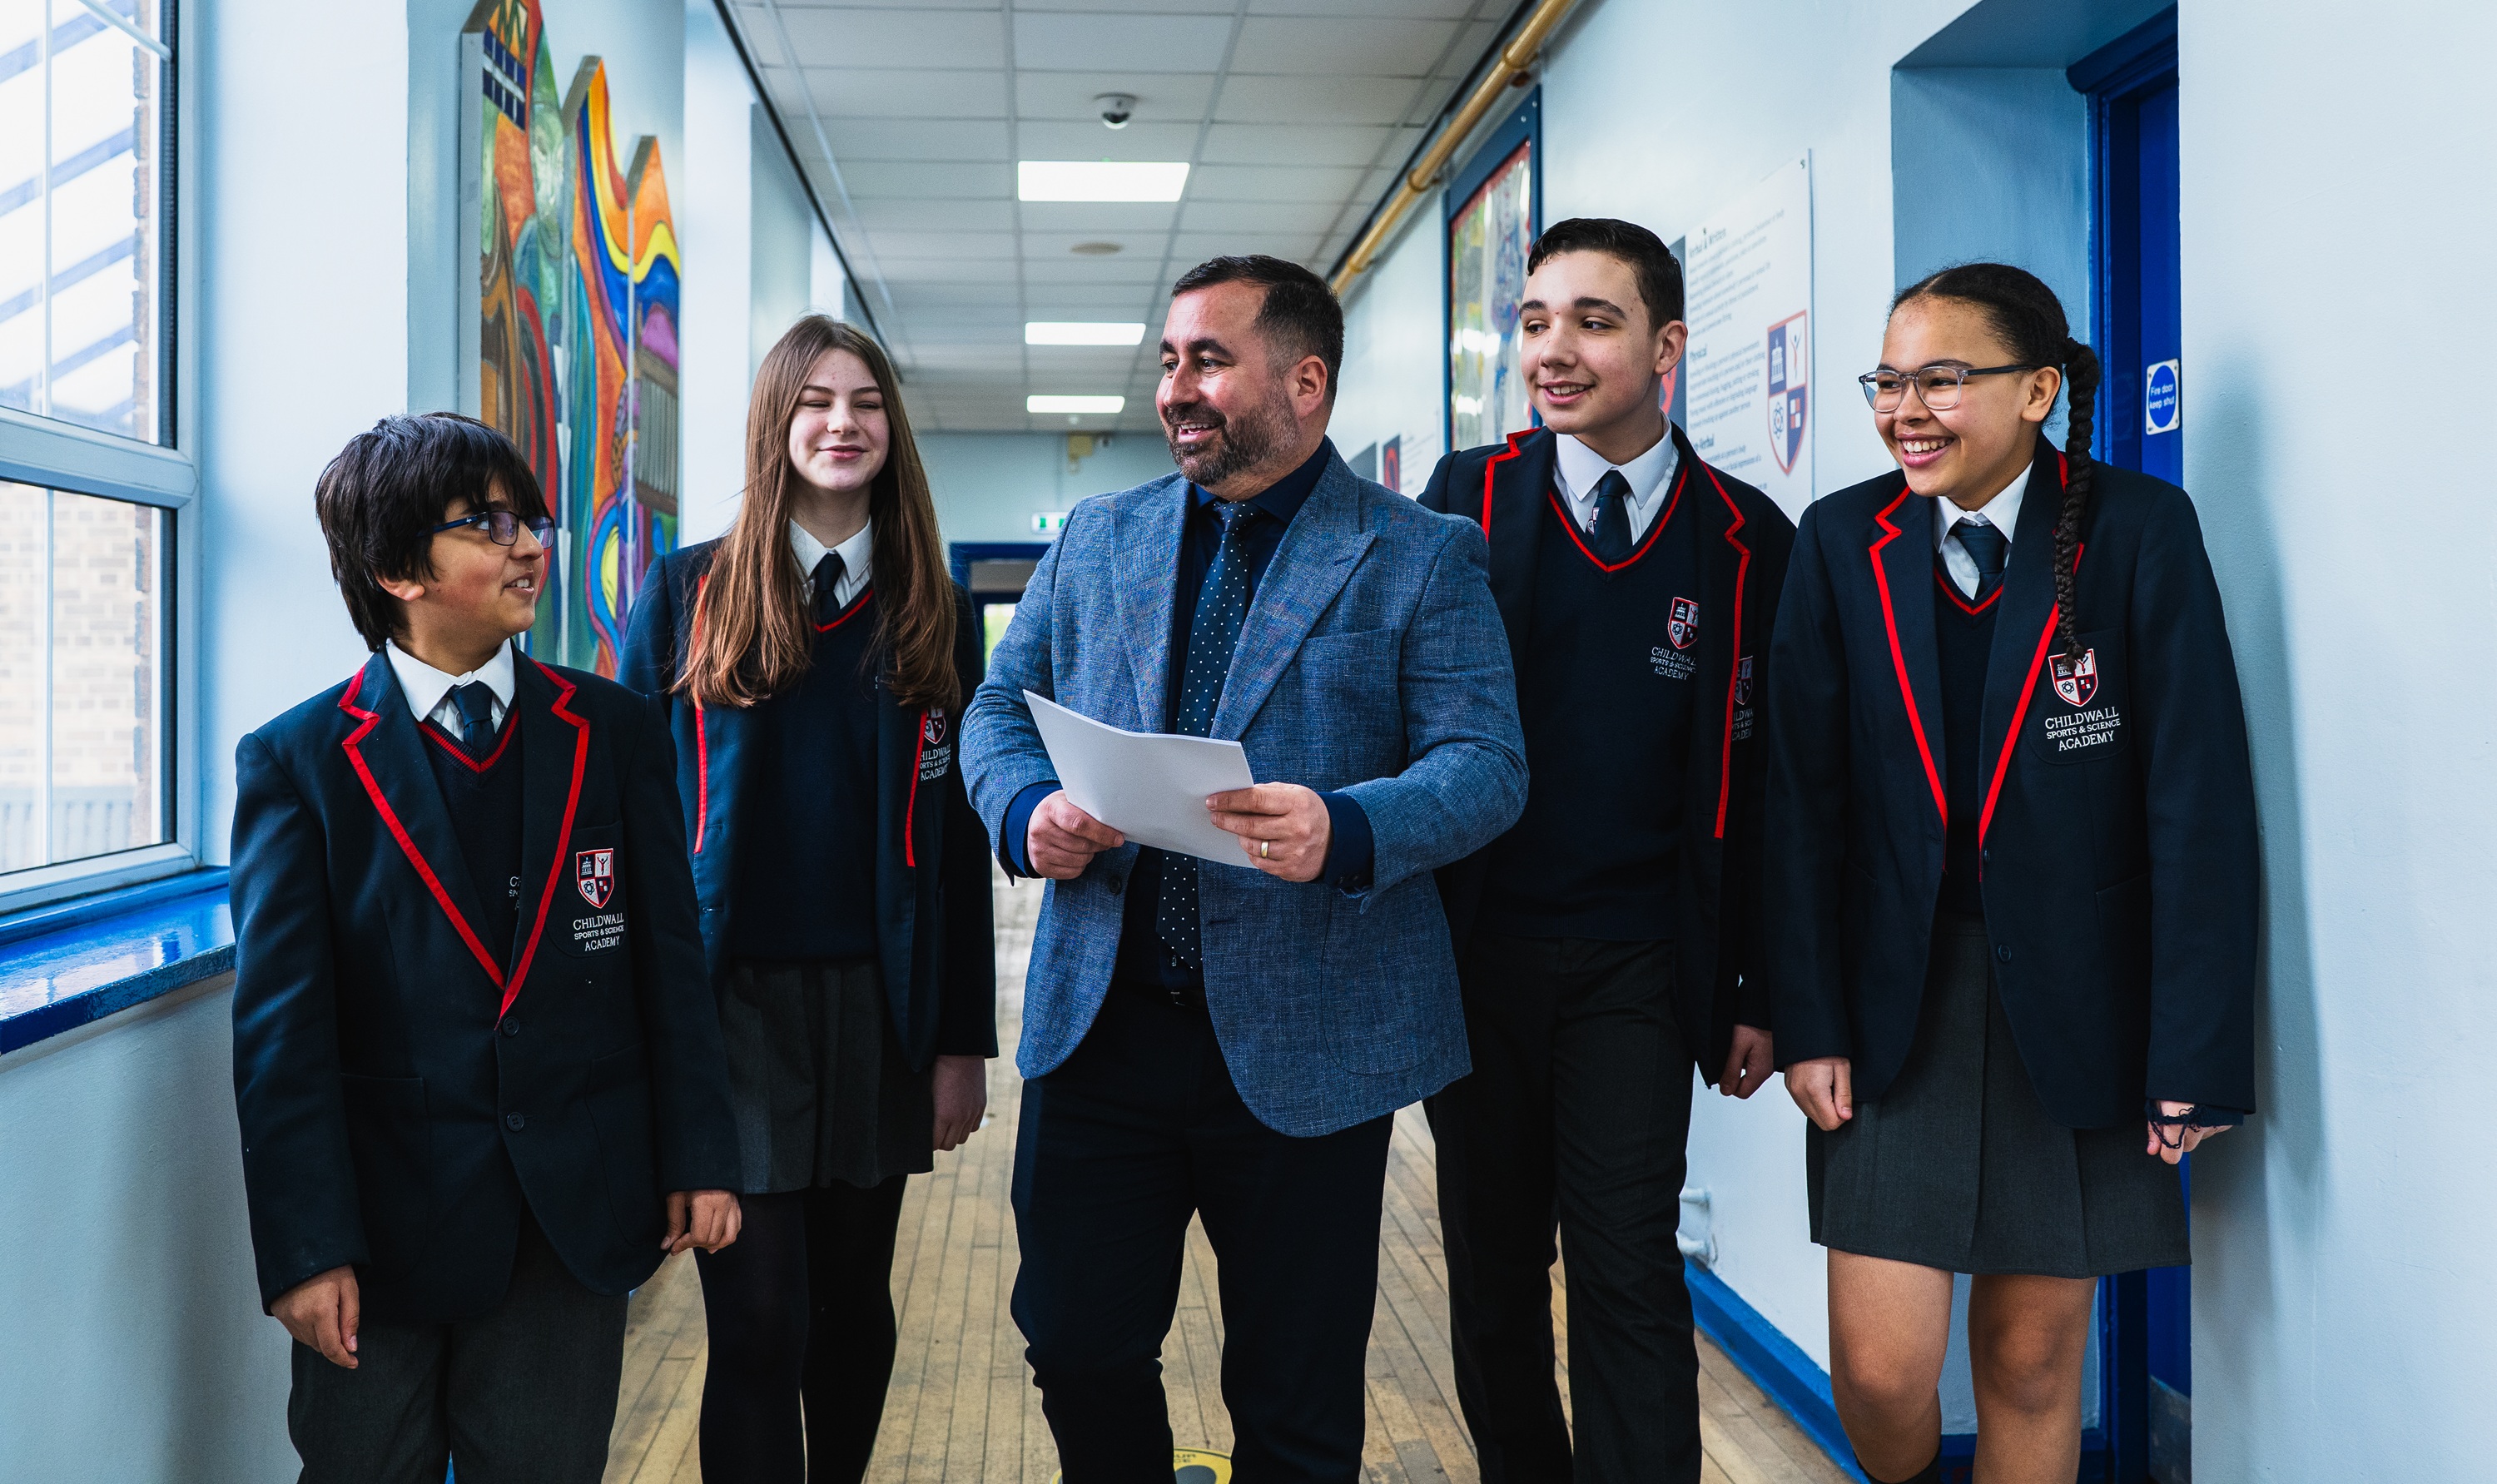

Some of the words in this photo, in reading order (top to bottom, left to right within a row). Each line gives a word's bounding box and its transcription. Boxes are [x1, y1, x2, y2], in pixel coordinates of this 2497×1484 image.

[2150, 386, 2161, 397] Fire
[2162, 384, 2174, 394] door
[2149, 400, 2162, 410] keep
[2163, 395, 2175, 406] shut
[1651, 647, 1696, 666] CHILDWAL
[1651, 657, 1670, 666] SPORTS
[1654, 666, 1690, 680] ACADEMY
[2044, 707, 2119, 730] CHILDWALL
[2046, 727, 2078, 740] SPORTS
[2087, 718, 2122, 732] SCIENCE
[2058, 730, 2114, 752] ACADEMY
[919, 761, 934, 769] ORTS
[921, 763, 948, 782] ACADEMY
[573, 912, 624, 931] CHILDWALL
[574, 930, 599, 941] SPORTS
[604, 925, 624, 936] SCIENCE
[584, 936, 620, 952] ACADEMY
